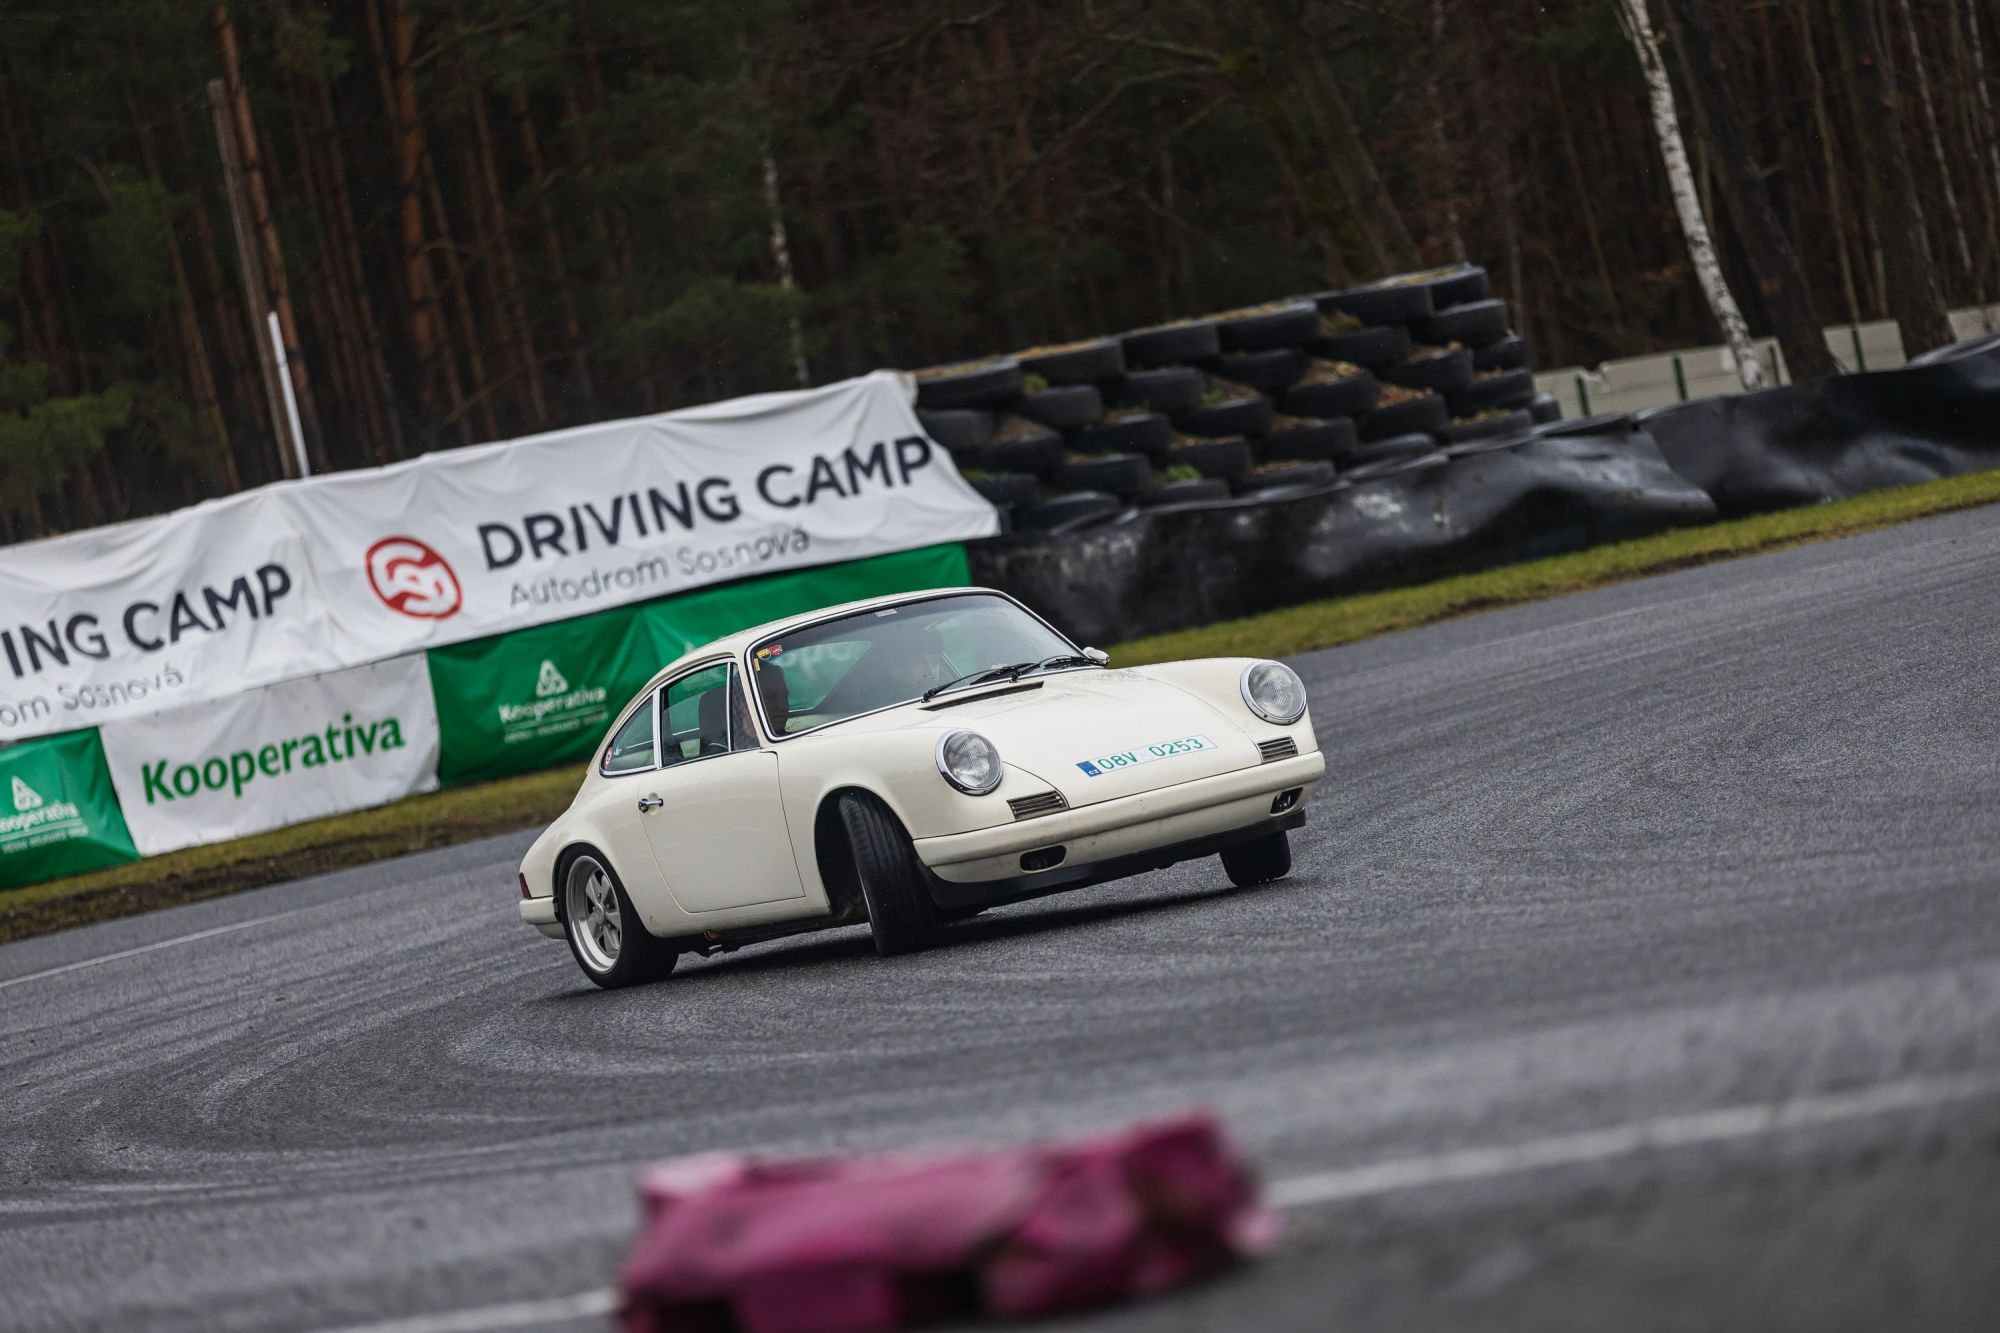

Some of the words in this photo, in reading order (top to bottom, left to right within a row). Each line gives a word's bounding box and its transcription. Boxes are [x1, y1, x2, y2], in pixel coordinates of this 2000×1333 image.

[478, 477, 741, 570] DRIVING
[756, 435, 931, 508] CAMP
[122, 562, 292, 652] CAMP
[510, 556, 670, 607] Autodrom
[57, 662, 184, 711] Sosnová
[498, 686, 606, 723] Kooperativa
[142, 713, 406, 805] Kooperativa
[1097, 752, 1138, 770] 08V
[1148, 738, 1204, 757] 0253
